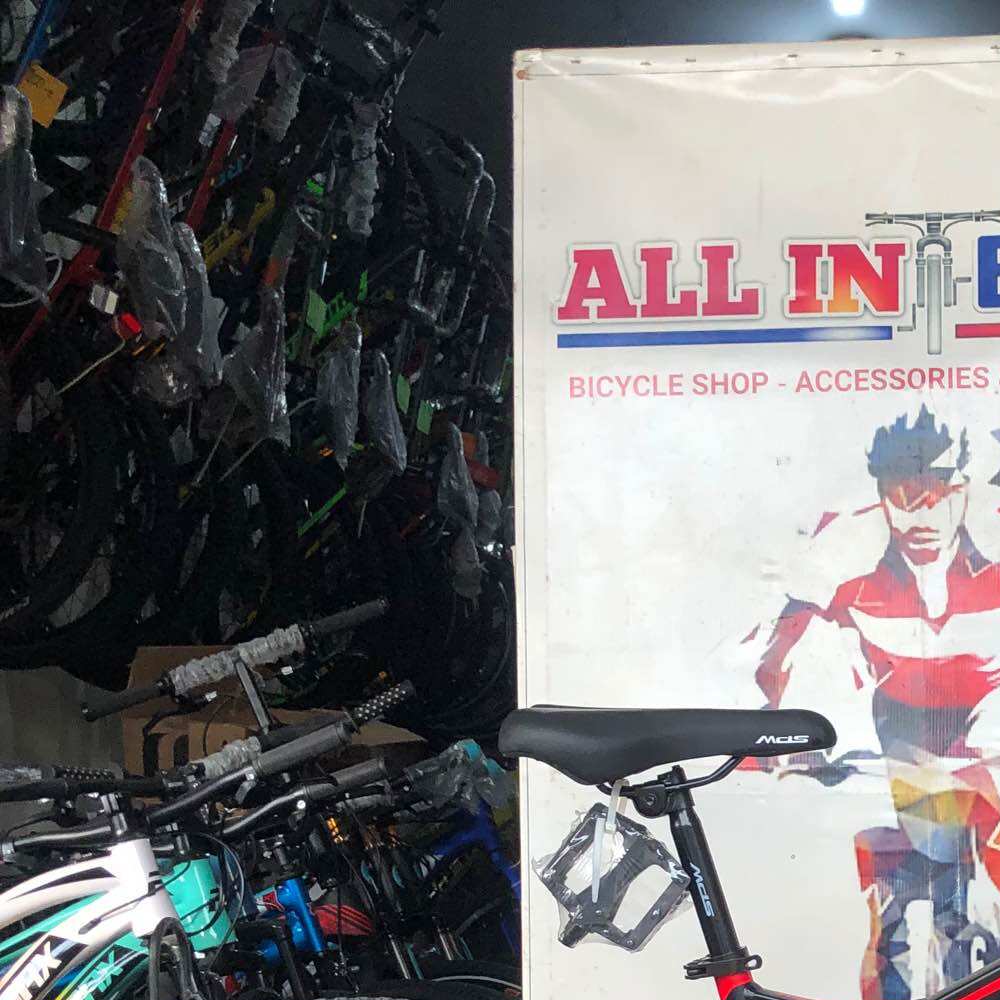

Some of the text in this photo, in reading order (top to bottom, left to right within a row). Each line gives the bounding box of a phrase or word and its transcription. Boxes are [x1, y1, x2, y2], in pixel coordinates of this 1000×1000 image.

[556, 243, 761, 322] ALL
[786, 241, 907, 316] IN
[569, 373, 684, 398] BICYCLE
[692, 370, 769, 394] SHOP
[795, 365, 990, 393] ACCESSORIES
